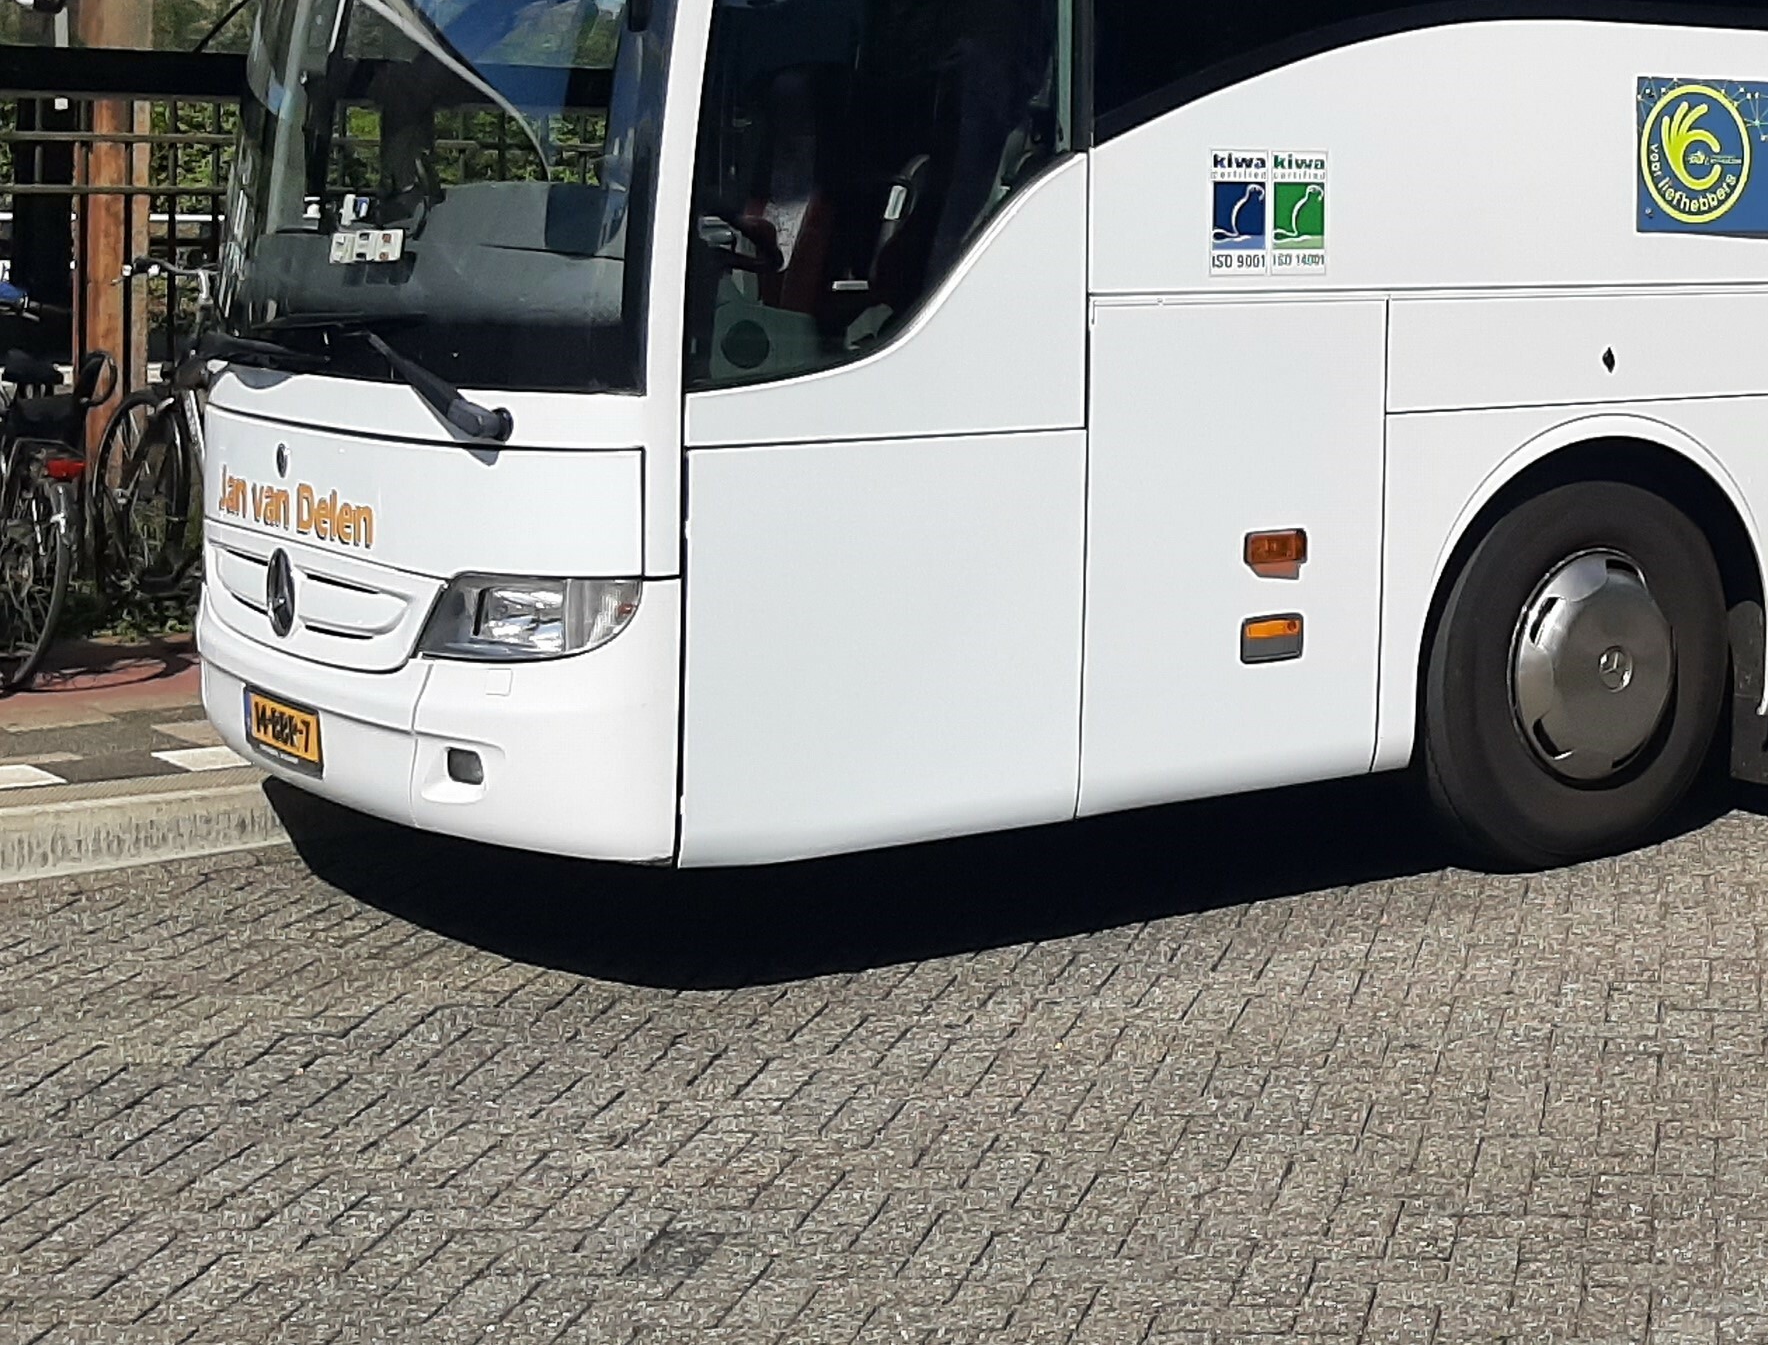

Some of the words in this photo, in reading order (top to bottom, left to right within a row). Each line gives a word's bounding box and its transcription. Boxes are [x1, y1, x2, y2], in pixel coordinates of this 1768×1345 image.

[1213, 153, 1266, 169] kiwa
[1273, 154, 1325, 170] kiwa
[1212, 254, 1233, 268] ISO
[1237, 254, 1266, 268] 9001
[219, 464, 247, 519] Jan
[251, 482, 290, 530] van
[296, 482, 374, 549] Delen
